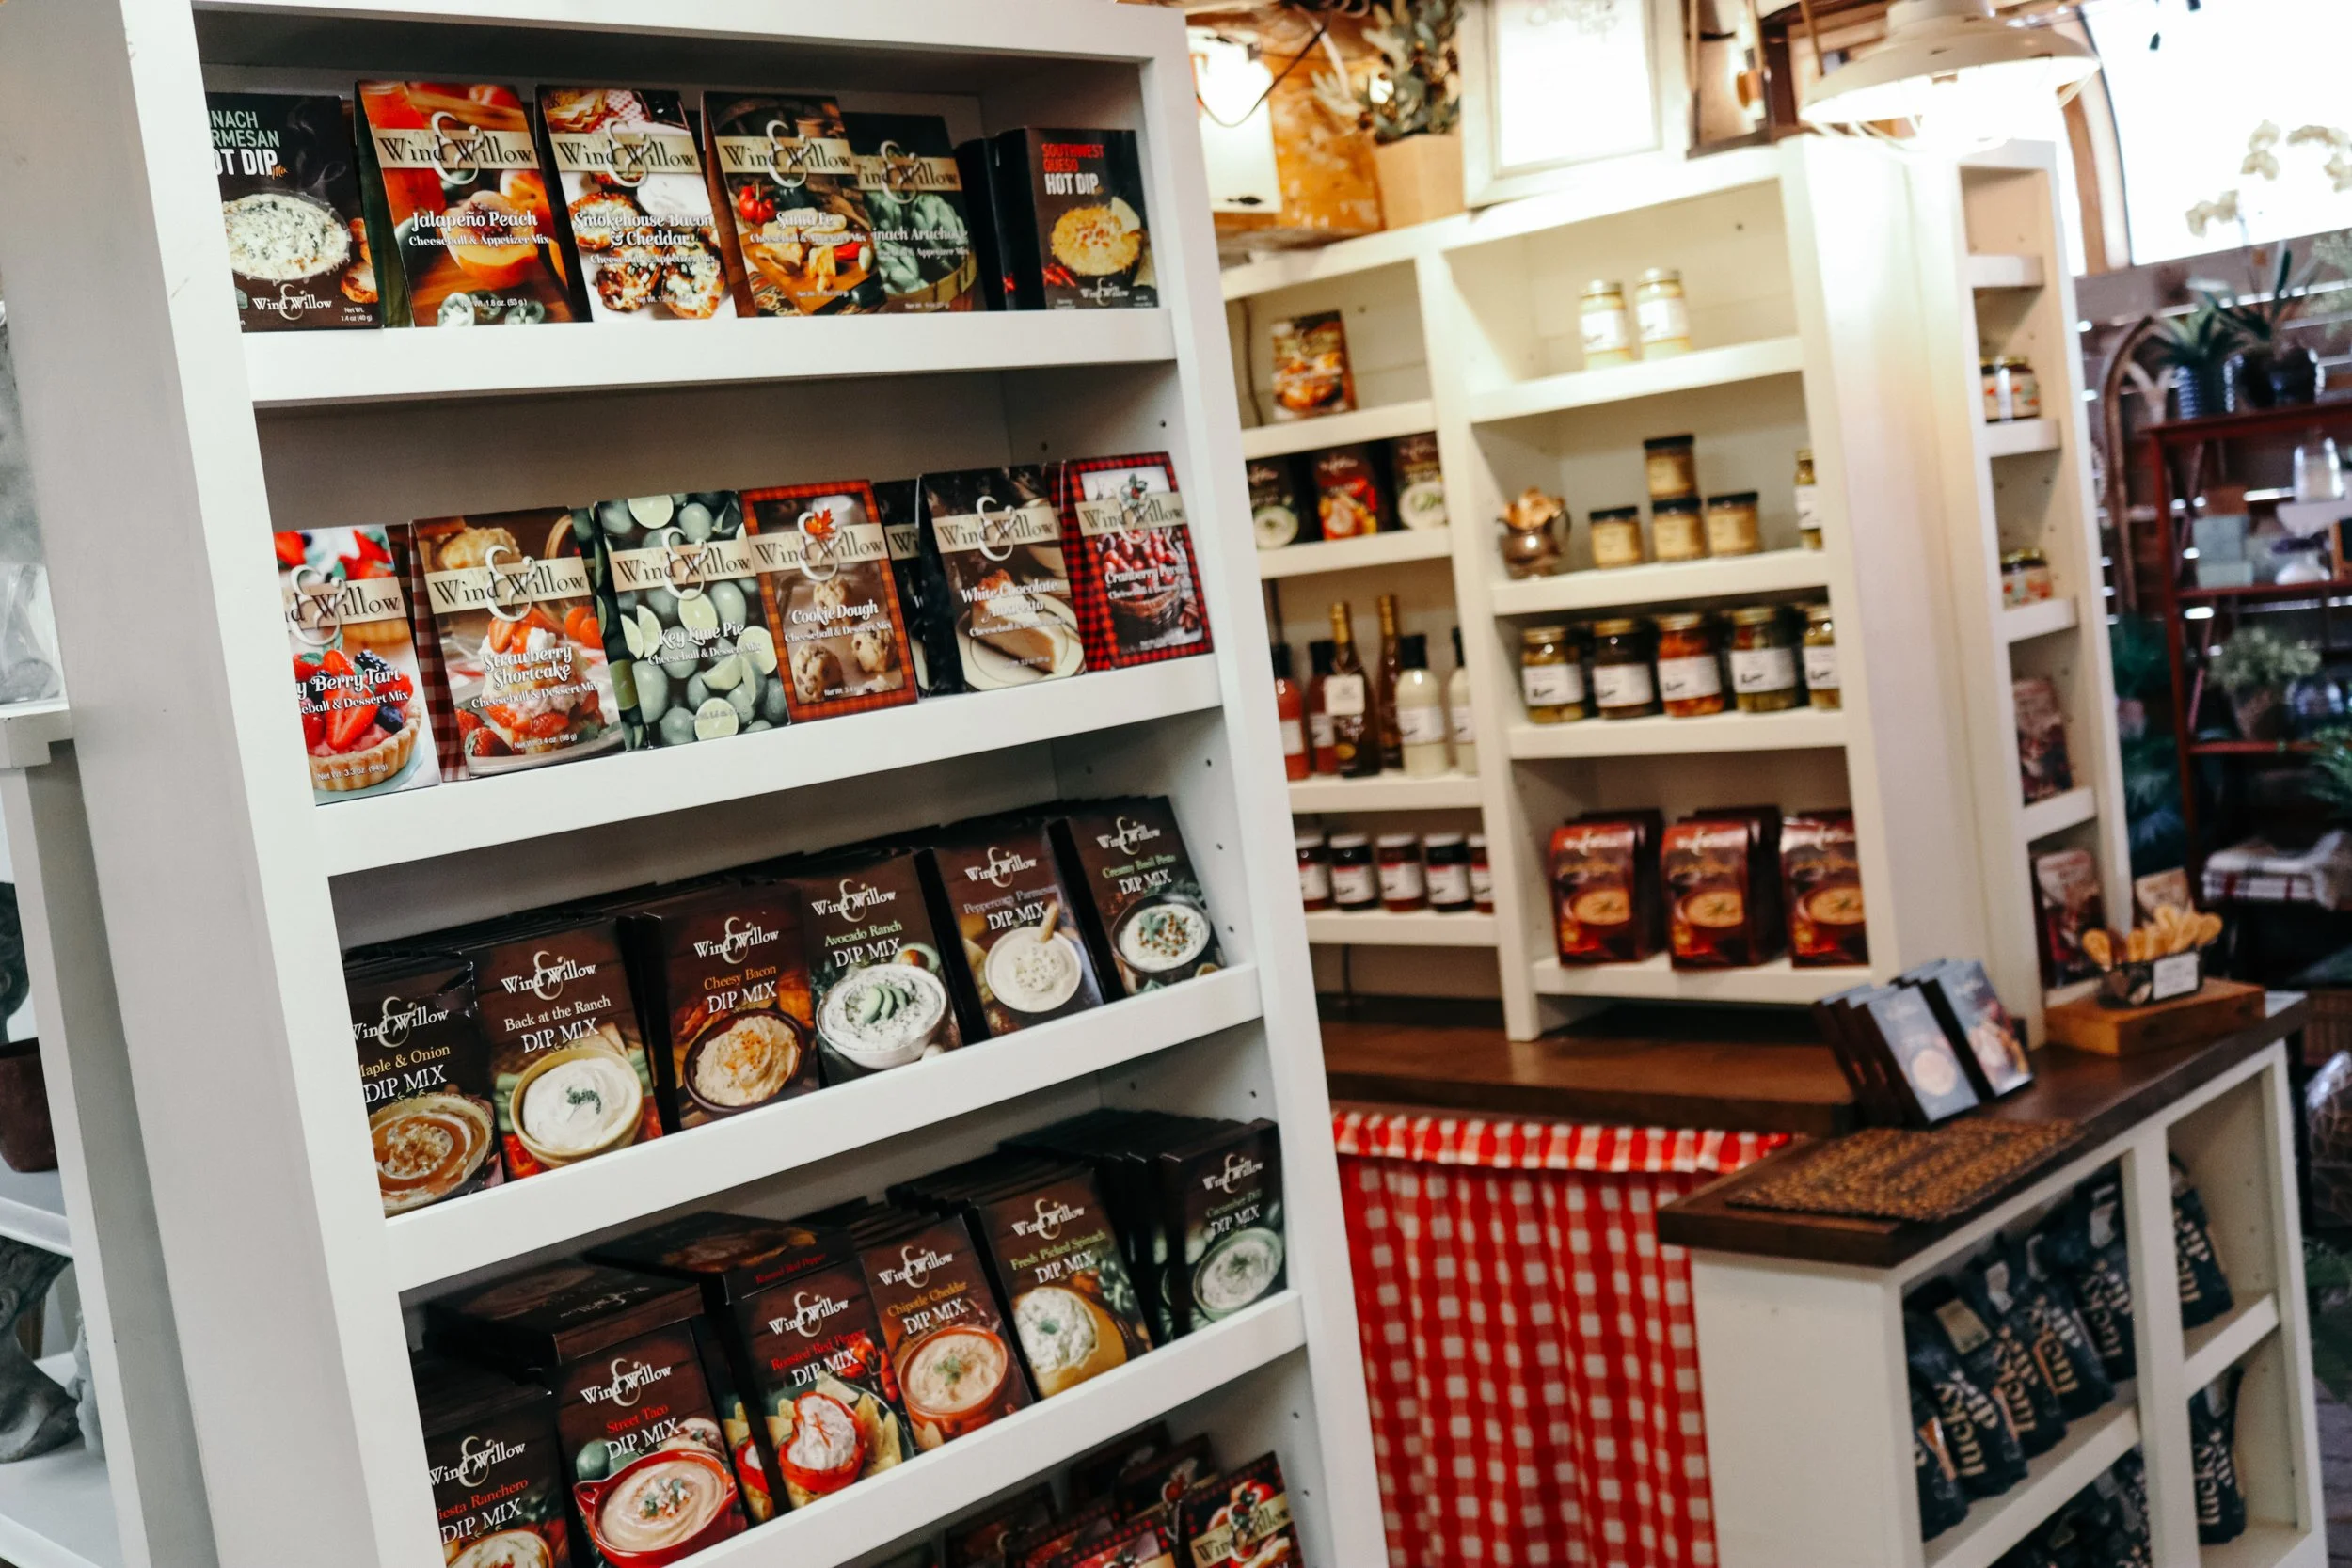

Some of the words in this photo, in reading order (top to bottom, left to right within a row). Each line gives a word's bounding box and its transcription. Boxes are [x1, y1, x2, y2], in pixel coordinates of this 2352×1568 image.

[210, 110, 259, 128] NACH
[211, 129, 280, 148] RMESAN
[378, 135, 448, 162] Wind
[451, 137, 533, 162] Willow
[213, 148, 235, 176] OT
[240, 149, 278, 176] DIP
[558, 140, 618, 165] Wind
[622, 141, 695, 166] Willow
[723, 143, 779, 166] Wind
[785, 144, 850, 167] Willow
[1044, 172, 1073, 195] HOT
[1074, 173, 1099, 195] DIP
[412, 211, 485, 232] Jalapeño
[489, 210, 537, 227] Peach
[574, 213, 664, 231] Smokehouse
[668, 214, 714, 228] Bacon
[818, 212, 834, 227] Fe
[409, 235, 467, 246] Cheeseball
[480, 235, 529, 247] Appetizer
[532, 234, 549, 245] Mix
[611, 231, 623, 248] &
[627, 230, 690, 245] Cheddar
[871, 227, 908, 241] inach
[253, 295, 287, 310] Wind
[291, 294, 332, 309] Willow
[939, 518, 990, 546] Wind
[993, 514, 1053, 539] Willow
[754, 536, 811, 565] Wind
[817, 531, 882, 558] Willow
[616, 551, 676, 583] Wind
[682, 547, 751, 576] Willow
[433, 571, 501, 605] Wind
[504, 565, 584, 595] Willow
[961, 586, 998, 603] White
[312, 587, 398, 619] Willow
[792, 607, 835, 625] Cookie
[836, 599, 879, 620] Dough
[659, 629, 687, 650] Key
[723, 621, 744, 637] Pie
[482, 646, 573, 672] Strawberry
[701, 649, 709, 658] &
[310, 674, 363, 692] Berry
[364, 666, 401, 685] Tart
[492, 663, 571, 690] Shortcake
[332, 700, 342, 710] &
[343, 695, 387, 708] Dessert
[389, 691, 409, 702] Mix
[471, 690, 528, 709] Cheeseball
[531, 689, 541, 700] &
[541, 685, 580, 698] Dessert
[1119, 876, 1142, 895] DIP
[1144, 869, 1172, 888] MIX
[811, 895, 850, 916] Wind
[851, 887, 896, 908] Willow
[987, 911, 1013, 930] DIP
[1015, 902, 1047, 923] MIX
[693, 934, 731, 958] Wind
[735, 926, 779, 948] Willow
[825, 928, 867, 947] Avocado
[869, 920, 903, 938] Ranch
[833, 945, 863, 968] DIP
[866, 937, 901, 960] MIX
[501, 969, 544, 994] Wind
[547, 959, 596, 984] Willow
[704, 974, 741, 990] Cheesy
[745, 966, 776, 980] Bacon
[707, 991, 738, 1014] DIP
[742, 981, 777, 1003] MIX
[504, 1014, 535, 1032] Back
[538, 1012, 550, 1022] at
[552, 1006, 572, 1020] the
[575, 994, 612, 1015] Ranch
[521, 1029, 555, 1053] DIP
[559, 1017, 600, 1043] MIX
[395, 1054, 407, 1068] &
[411, 1046, 451, 1064] Onion
[363, 1077, 398, 1103] DIP
[404, 1064, 448, 1092] MIX
[1035, 1261, 1061, 1284] DIP
[1063, 1250, 1096, 1273] MIX
[769, 1313, 805, 1335] Wind
[806, 1298, 849, 1321] Willow
[903, 1311, 930, 1335] DIP
[932, 1298, 966, 1323] MIX
[791, 1362, 821, 1386] DIP
[823, 1347, 859, 1374] MIX
[580, 1378, 622, 1405] Wind
[625, 1364, 672, 1389] Willow
[606, 1415, 640, 1433] Street
[641, 1404, 669, 1420] Taco
[605, 1433, 638, 1460] DIP
[641, 1418, 680, 1447] MIX
[429, 1457, 469, 1486] Wind
[473, 1442, 526, 1469] Willow
[437, 1503, 467, 1520] iesta
[470, 1479, 529, 1509] Ranchero
[440, 1516, 476, 1544] DIP
[482, 1497, 523, 1530] MIX
